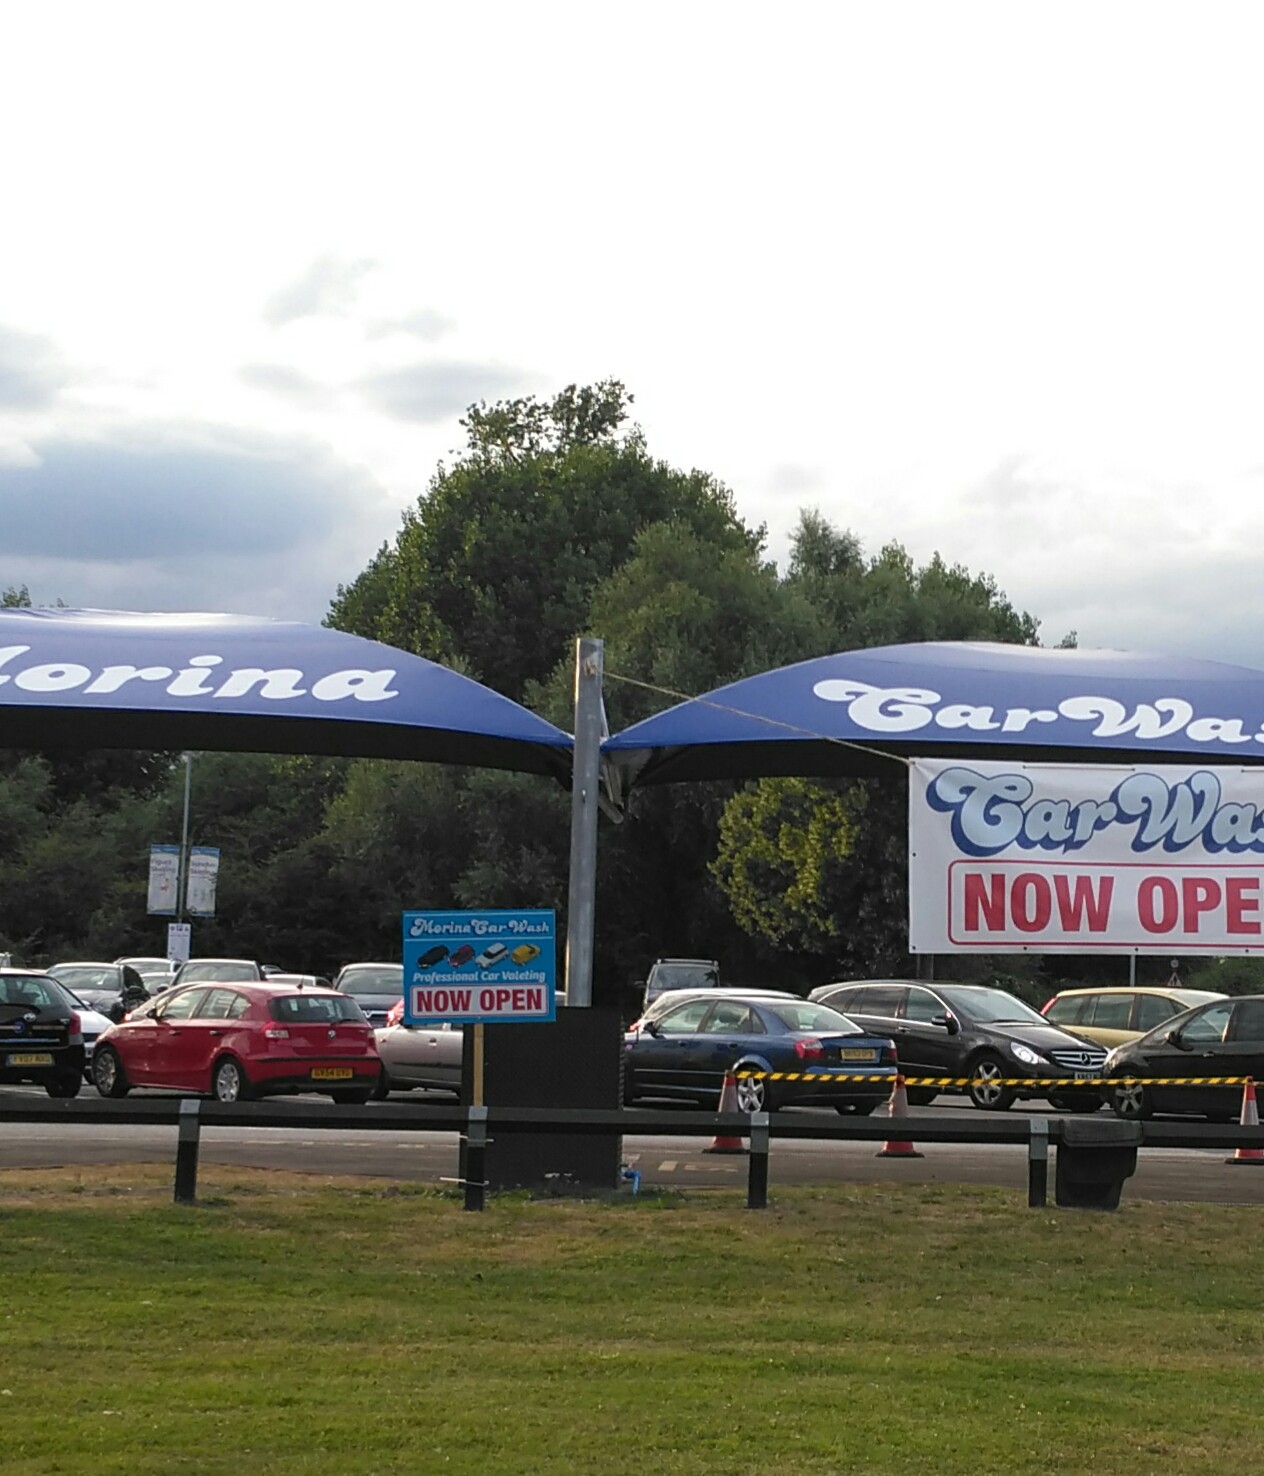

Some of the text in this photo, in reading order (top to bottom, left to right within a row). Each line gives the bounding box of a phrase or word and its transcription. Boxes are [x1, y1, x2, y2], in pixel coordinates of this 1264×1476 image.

[813, 679, 1057, 732] Car
[926, 767, 1115, 857] Car
[964, 873, 1114, 933] NOW
[410, 918, 550, 937] Morina Car Wash
[413, 970, 546, 984] Professional Car Valeting
[417, 989, 542, 1013] NOW OPEN
